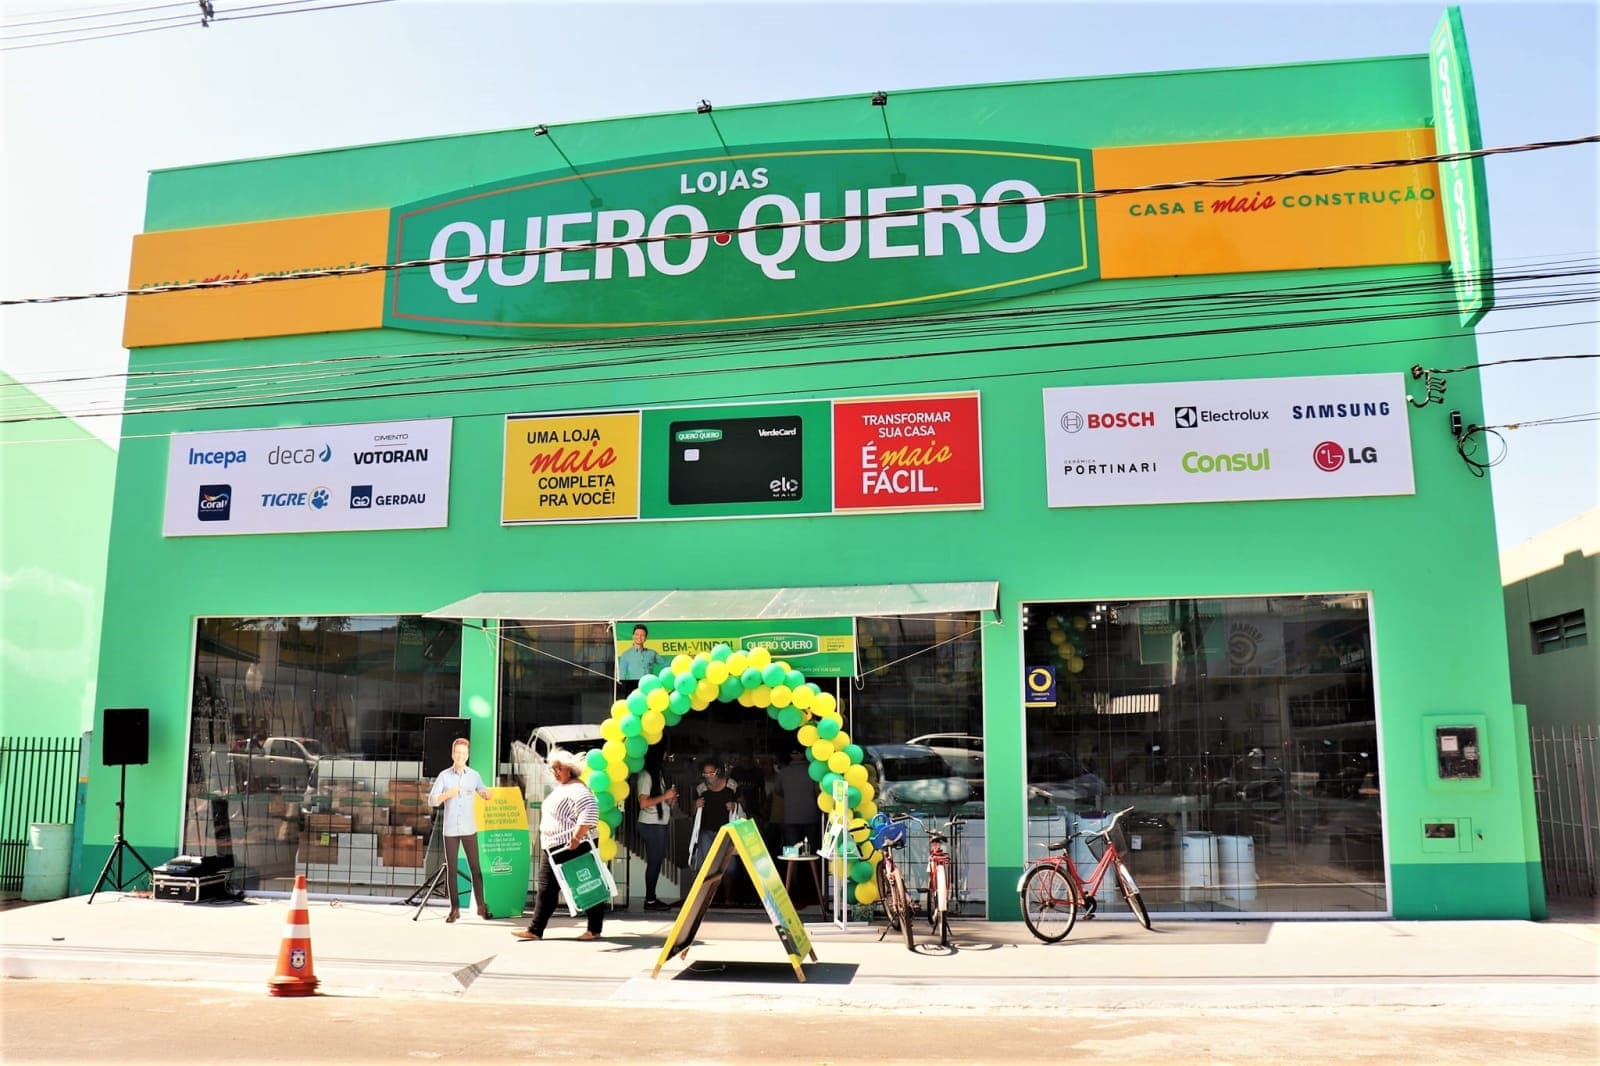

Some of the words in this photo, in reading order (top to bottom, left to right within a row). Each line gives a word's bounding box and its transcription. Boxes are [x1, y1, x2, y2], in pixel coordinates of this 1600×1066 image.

[680, 167, 769, 196] LOJAS
[1129, 202, 1185, 217] CASA
[1194, 200, 1205, 213] E
[1211, 191, 1276, 214] mais
[1282, 186, 1435, 209] CONSTRUÇÃO
[429, 204, 710, 304] QUERO
[738, 178, 1048, 280] QUERO
[862, 411, 951, 426] TRANSFORMAR
[1201, 408, 1270, 423] Electrolux
[1292, 402, 1391, 420] SAMSUNG
[1088, 411, 1155, 429] BOSCH
[374, 433, 408, 441] CIMENTO
[527, 430, 559, 444] UMA
[563, 428, 600, 443] LOJA
[758, 427, 797, 437] VerdeCard
[878, 426, 902, 438] SUA
[904, 425, 936, 437] CASA
[188, 447, 247, 469] Incepa
[268, 446, 315, 465] deca
[353, 448, 428, 465] VOTORAN
[530, 440, 617, 475] mais
[862, 441, 878, 469] É
[880, 440, 952, 468] mais
[1182, 447, 1271, 474] Consul
[1348, 446, 1378, 464] LG
[1064, 462, 1157, 476] PORTINARI
[538, 474, 615, 490] COMPLETA
[862, 465, 939, 494] FÁCIL.
[200, 499, 225, 509] Coral
[261, 492, 307, 507] TIGRE
[375, 493, 426, 506] GERDAU
[539, 493, 568, 507] PRA
[572, 488, 616, 506] VOCÊ!
[746, 641, 779, 650] QUERO
[780, 639, 813, 650] QUERO
